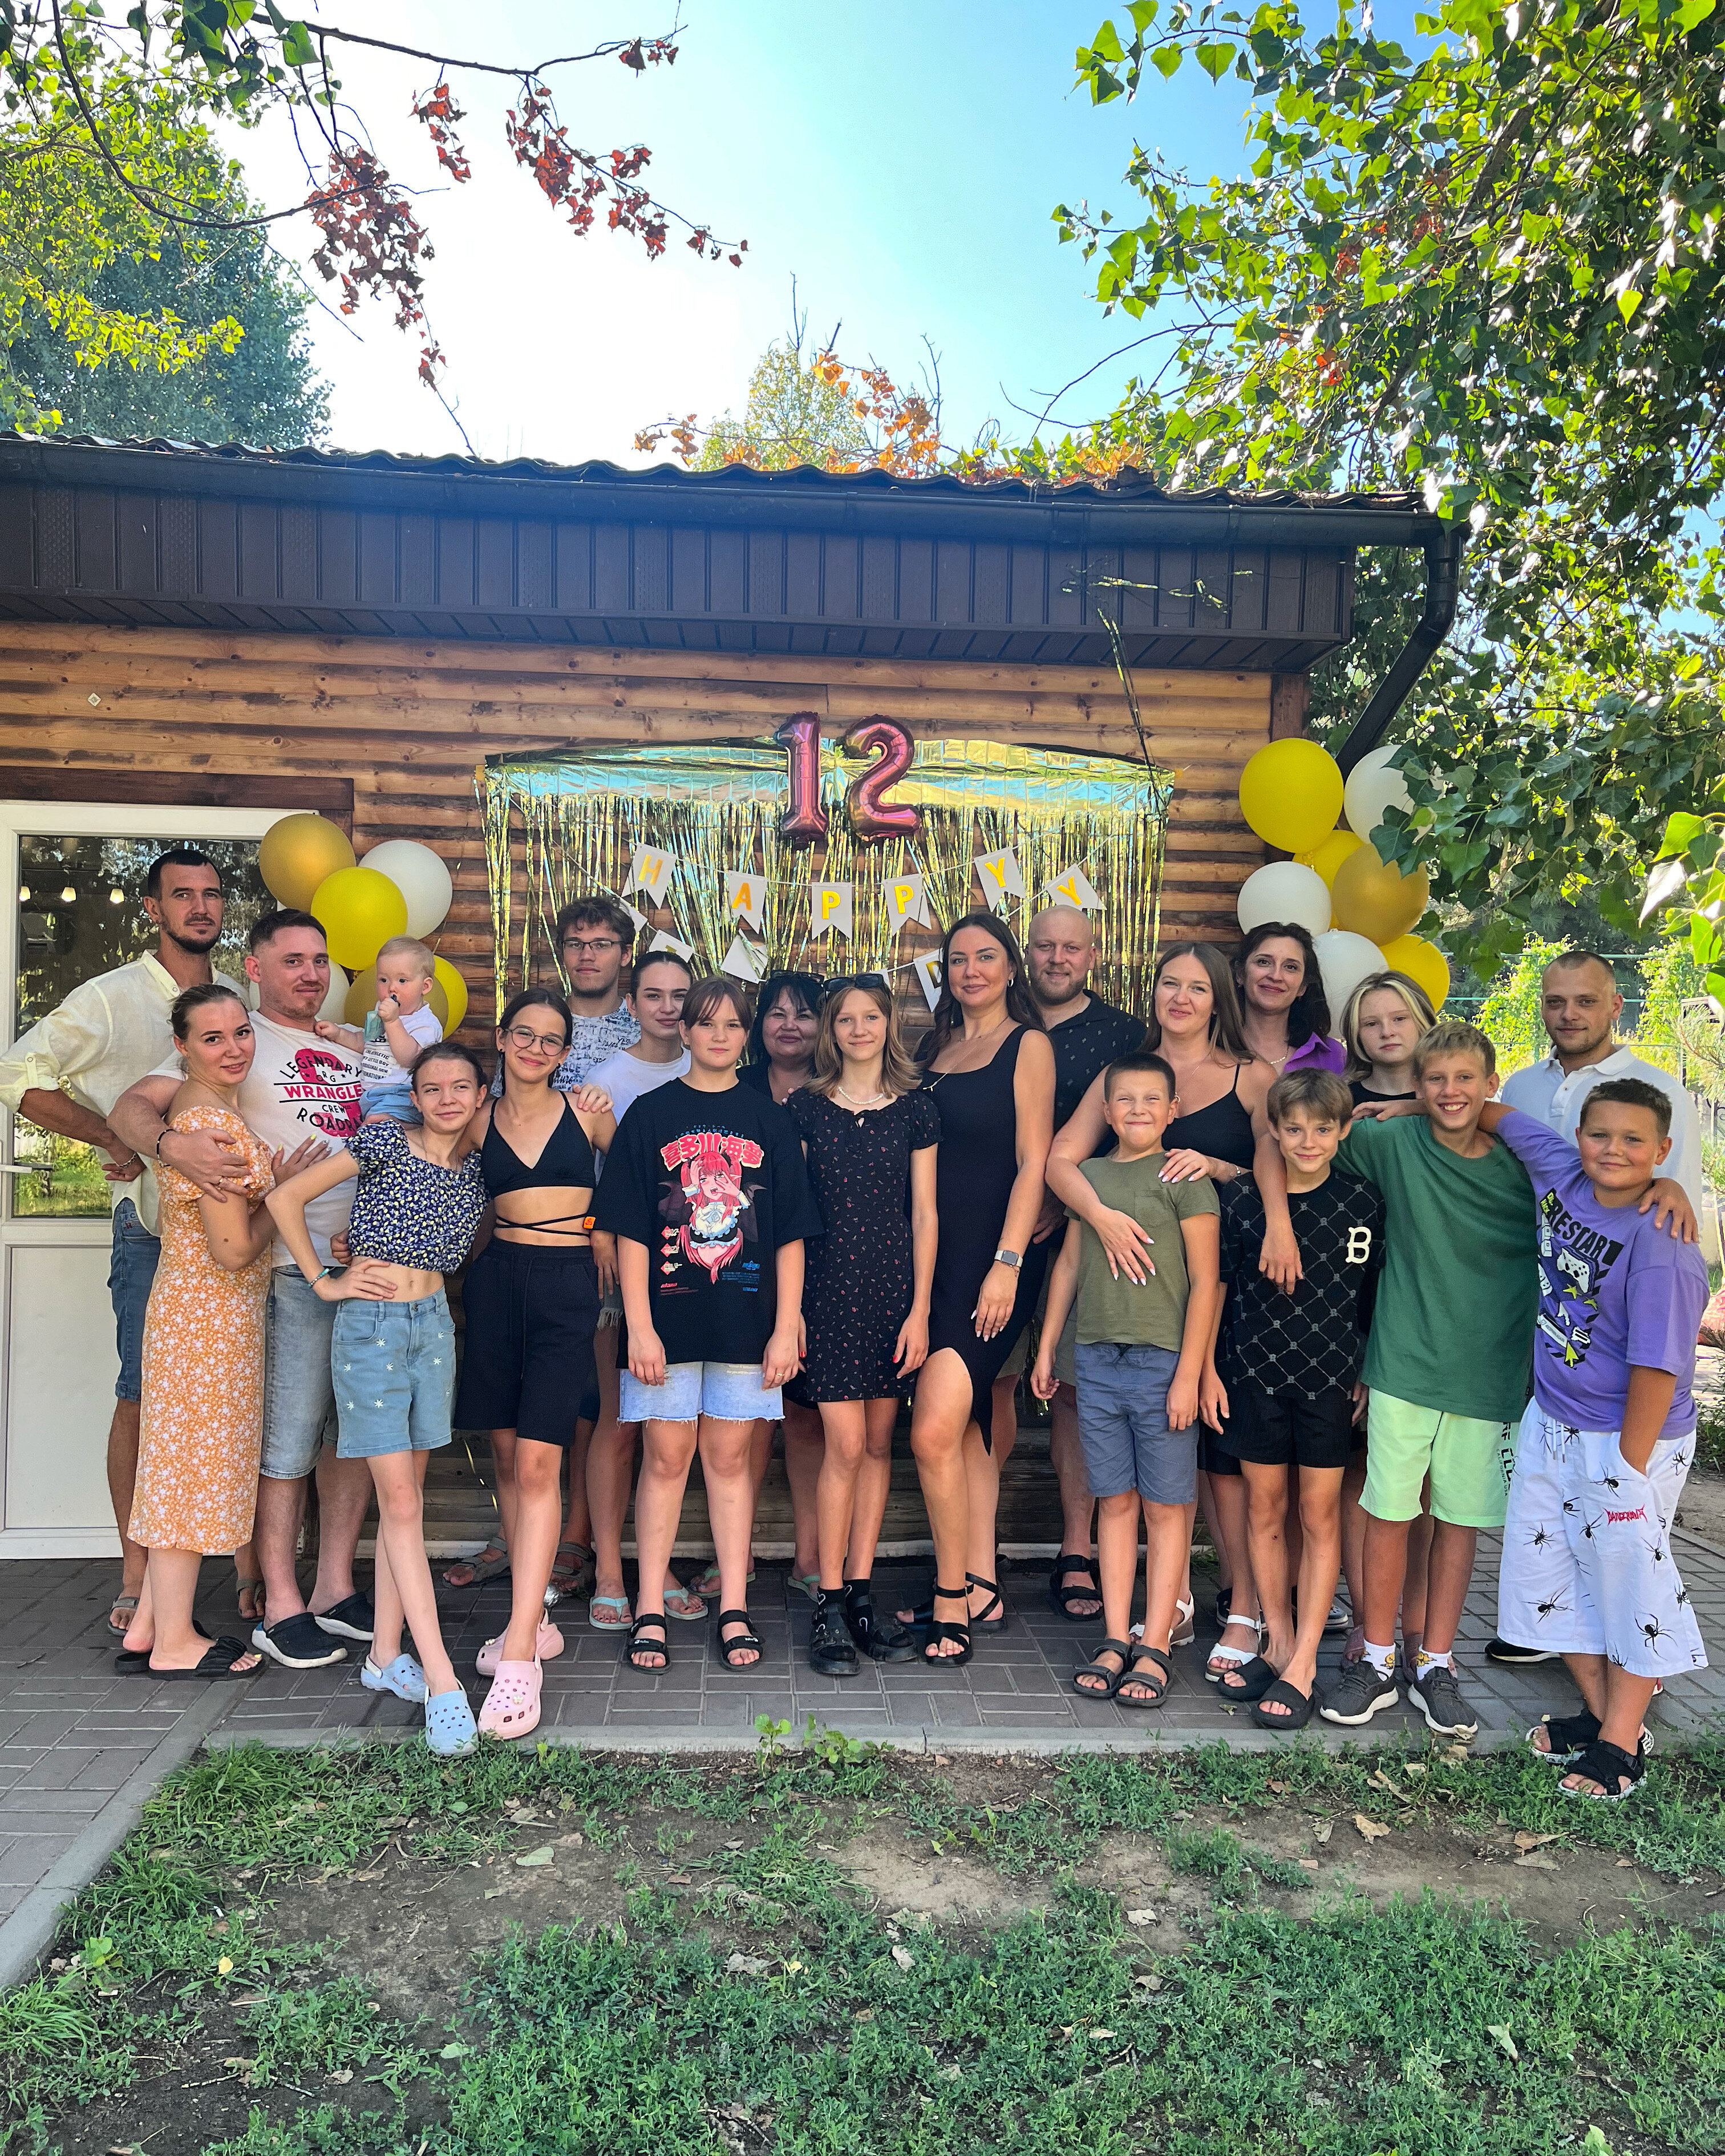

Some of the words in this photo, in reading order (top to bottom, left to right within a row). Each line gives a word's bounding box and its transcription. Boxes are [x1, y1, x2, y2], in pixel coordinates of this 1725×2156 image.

[774, 711, 922, 841] 12
[280, 1055, 362, 1079] LEGENDARY
[316, 1071, 336, 1082] ORG
[284, 1084, 363, 1100] WRANGLE
[297, 1107, 363, 1132] ROADRA
[322, 1105, 346, 1113] CREW
[1541, 1188, 1624, 1267] RESTART
[1345, 1226, 1372, 1264] B
